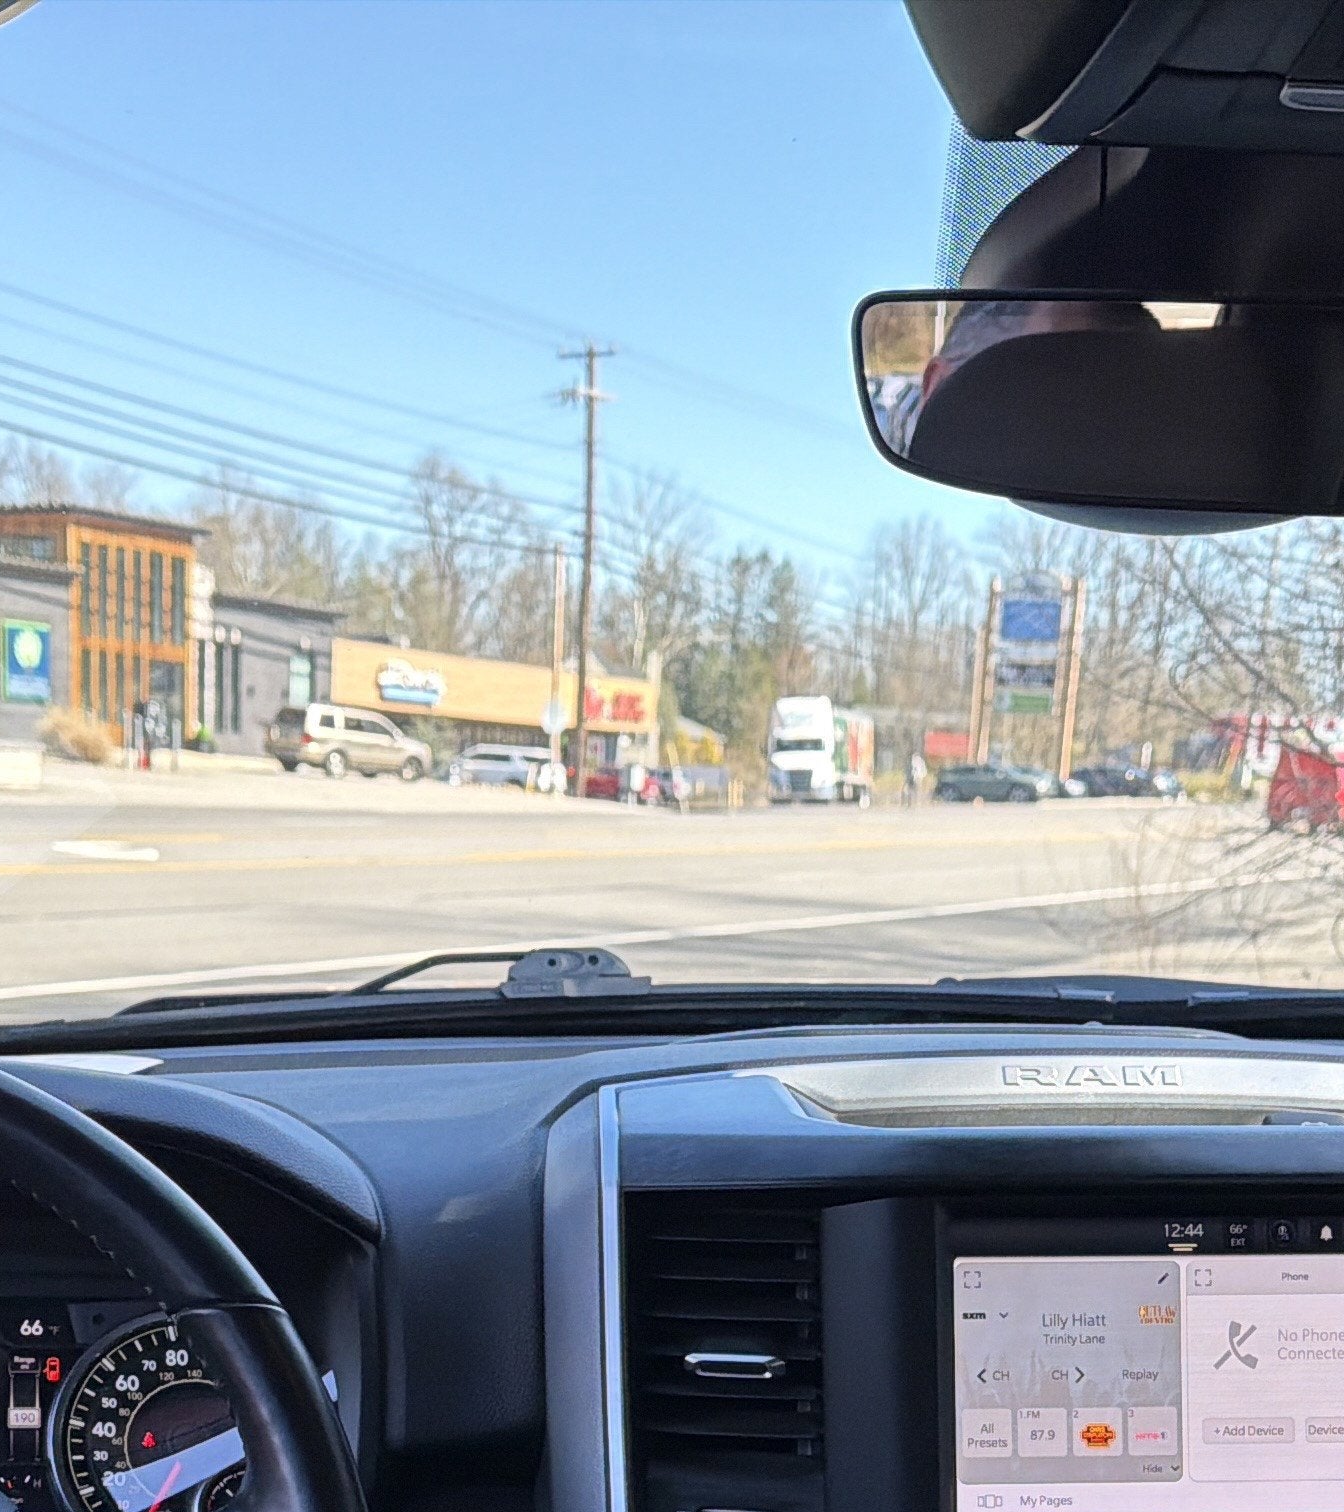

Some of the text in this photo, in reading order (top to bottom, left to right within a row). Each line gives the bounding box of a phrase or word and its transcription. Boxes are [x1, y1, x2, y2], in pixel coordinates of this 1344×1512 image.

[1002, 1063, 1183, 1087] RAM
[1164, 1223, 1204, 1238] 12:44
[1281, 1272, 1309, 1283] Phone
[962, 1312, 987, 1320] sxm
[1041, 1313, 1106, 1330] Lilly Hiatt
[20, 1320, 43, 1336] 66
[1043, 1333, 1105, 1347] Trinity Lane
[1277, 1329, 1298, 1342] No
[165, 1349, 189, 1367] 80
[141, 1359, 157, 1372] 70
[158, 1371, 175, 1381] 120
[186, 1368, 203, 1379] 140
[992, 1370, 1010, 1381] CH
[1051, 1370, 1069, 1381] CH
[1122, 1369, 1159, 1383] Replay
[115, 1374, 140, 1392] 60
[126, 1391, 143, 1401] 100
[101, 1397, 118, 1409] 50
[13, 1412, 36, 1425] 190
[91, 1421, 117, 1438] 40
[980, 1423, 994, 1433] All
[1248, 1425, 1284, 1436] Device
[1308, 1424, 1344, 1436] Device
[1030, 1429, 1056, 1441] 87.9
[967, 1437, 1008, 1448] Presets
[93, 1450, 109, 1462] 30
[1142, 1464, 1163, 1473] Hide
[102, 1470, 126, 1487] 20
[1019, 1495, 1073, 1508] My Pages
